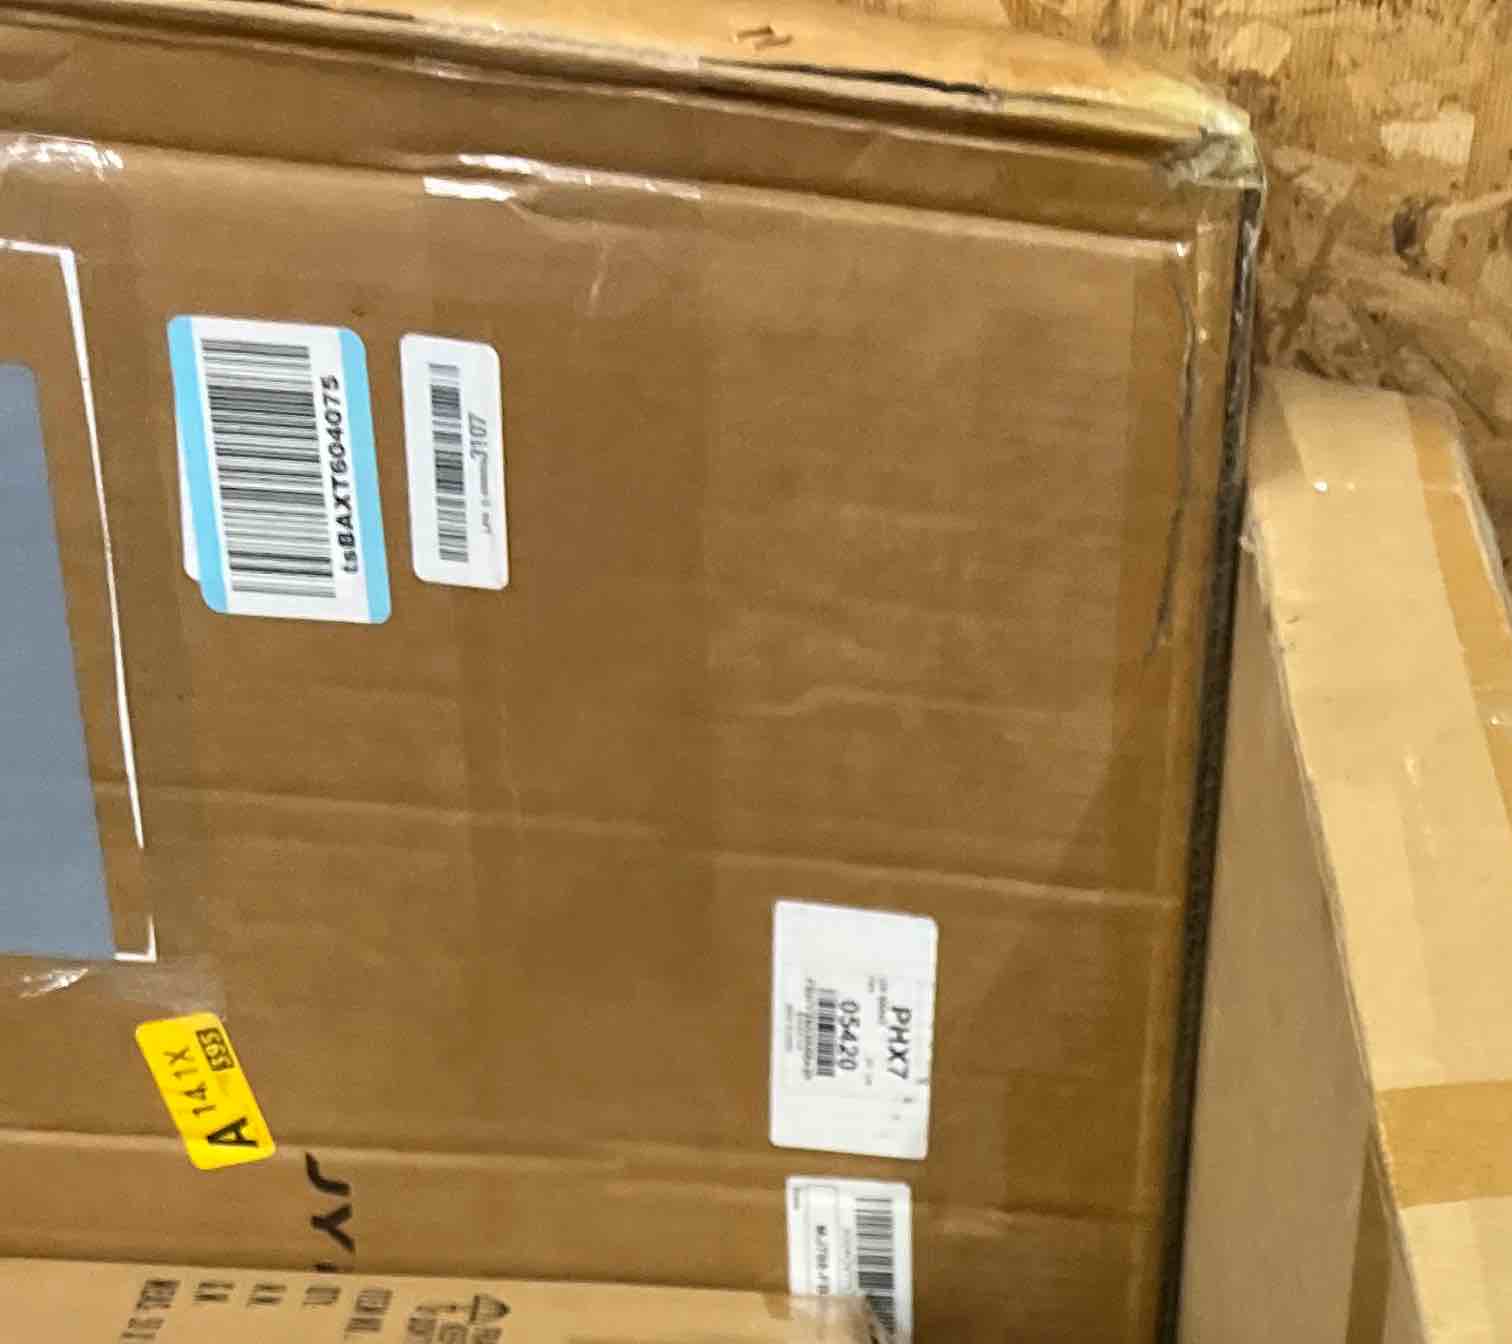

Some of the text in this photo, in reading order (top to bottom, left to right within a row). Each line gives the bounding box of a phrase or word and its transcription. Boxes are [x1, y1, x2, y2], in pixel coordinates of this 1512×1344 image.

[320, 374, 359, 574] tsBAXT604075
[839, 1000, 860, 1070] 05420
[887, 1006, 912, 1080] PHX7
[206, 1117, 259, 1148] A
